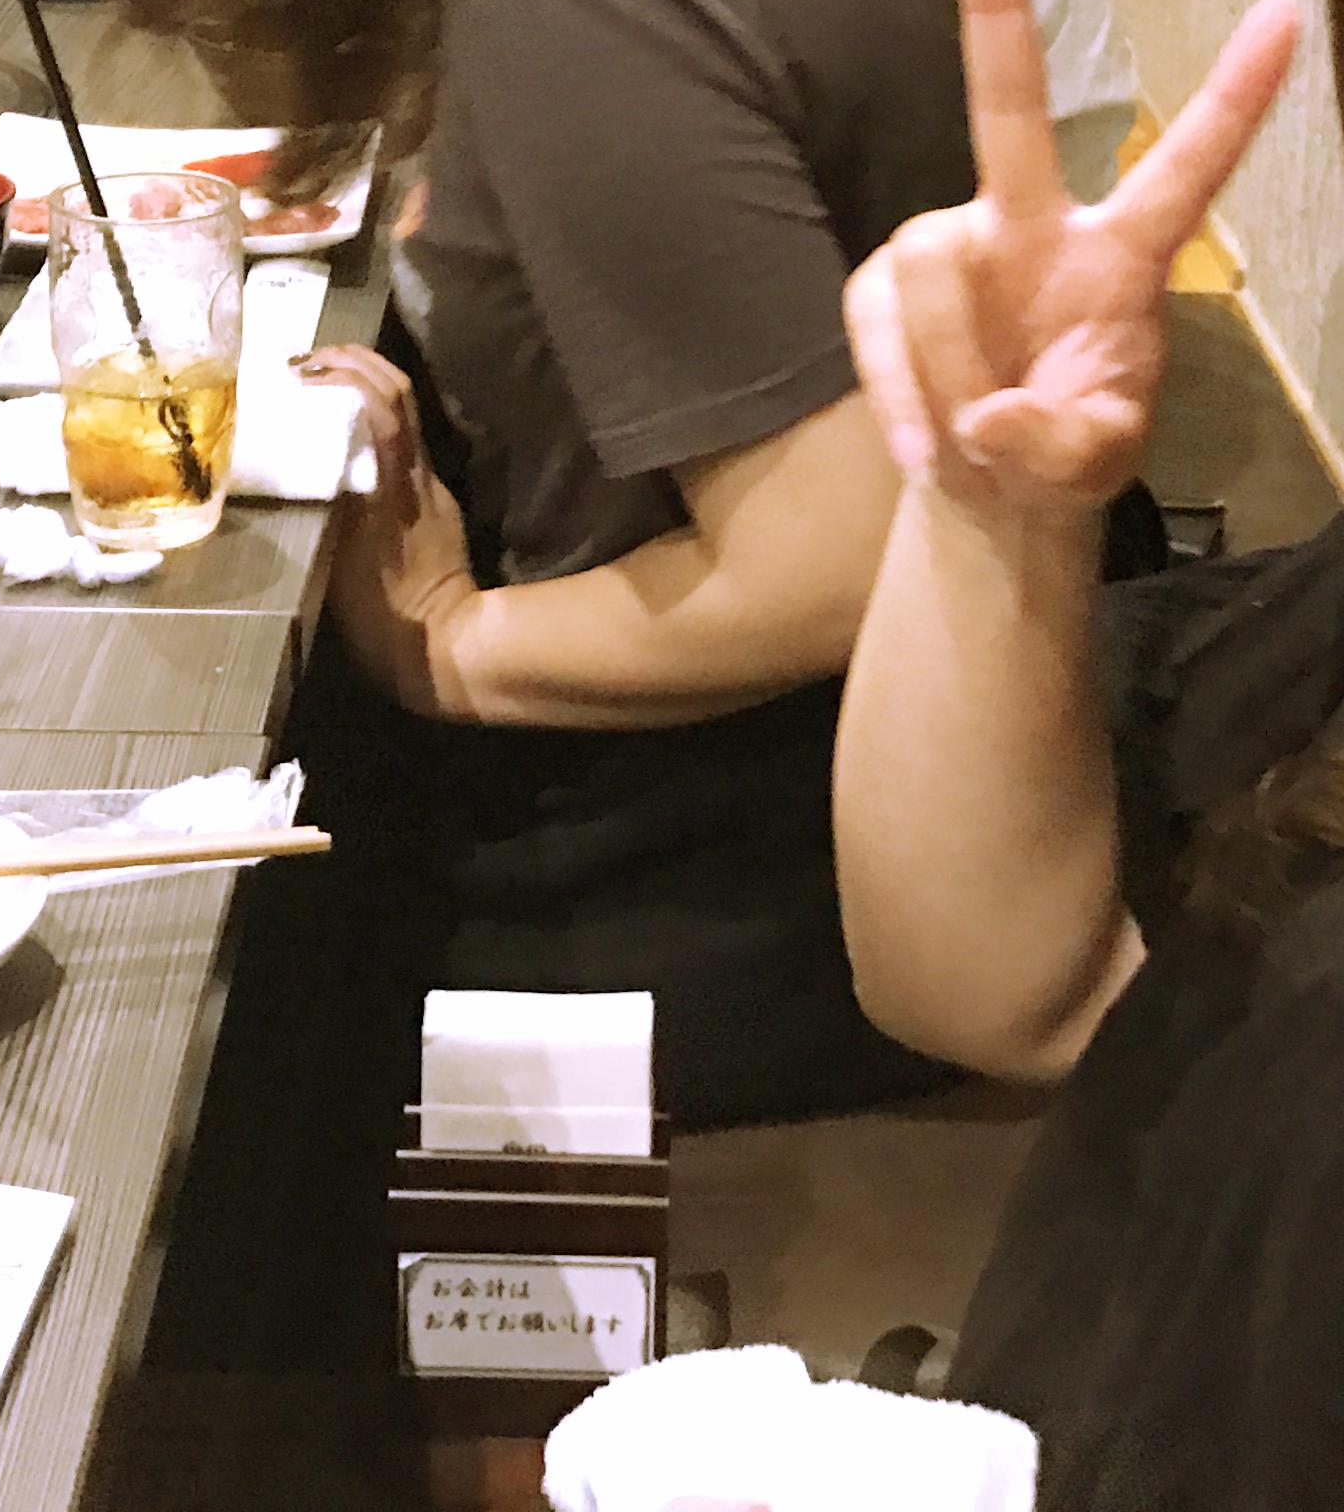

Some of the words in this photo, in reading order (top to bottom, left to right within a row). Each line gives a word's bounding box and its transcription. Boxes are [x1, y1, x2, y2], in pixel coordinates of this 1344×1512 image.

[432, 1276, 530, 1300] お会計は
[423, 1308, 623, 1335] お席でお願いします
